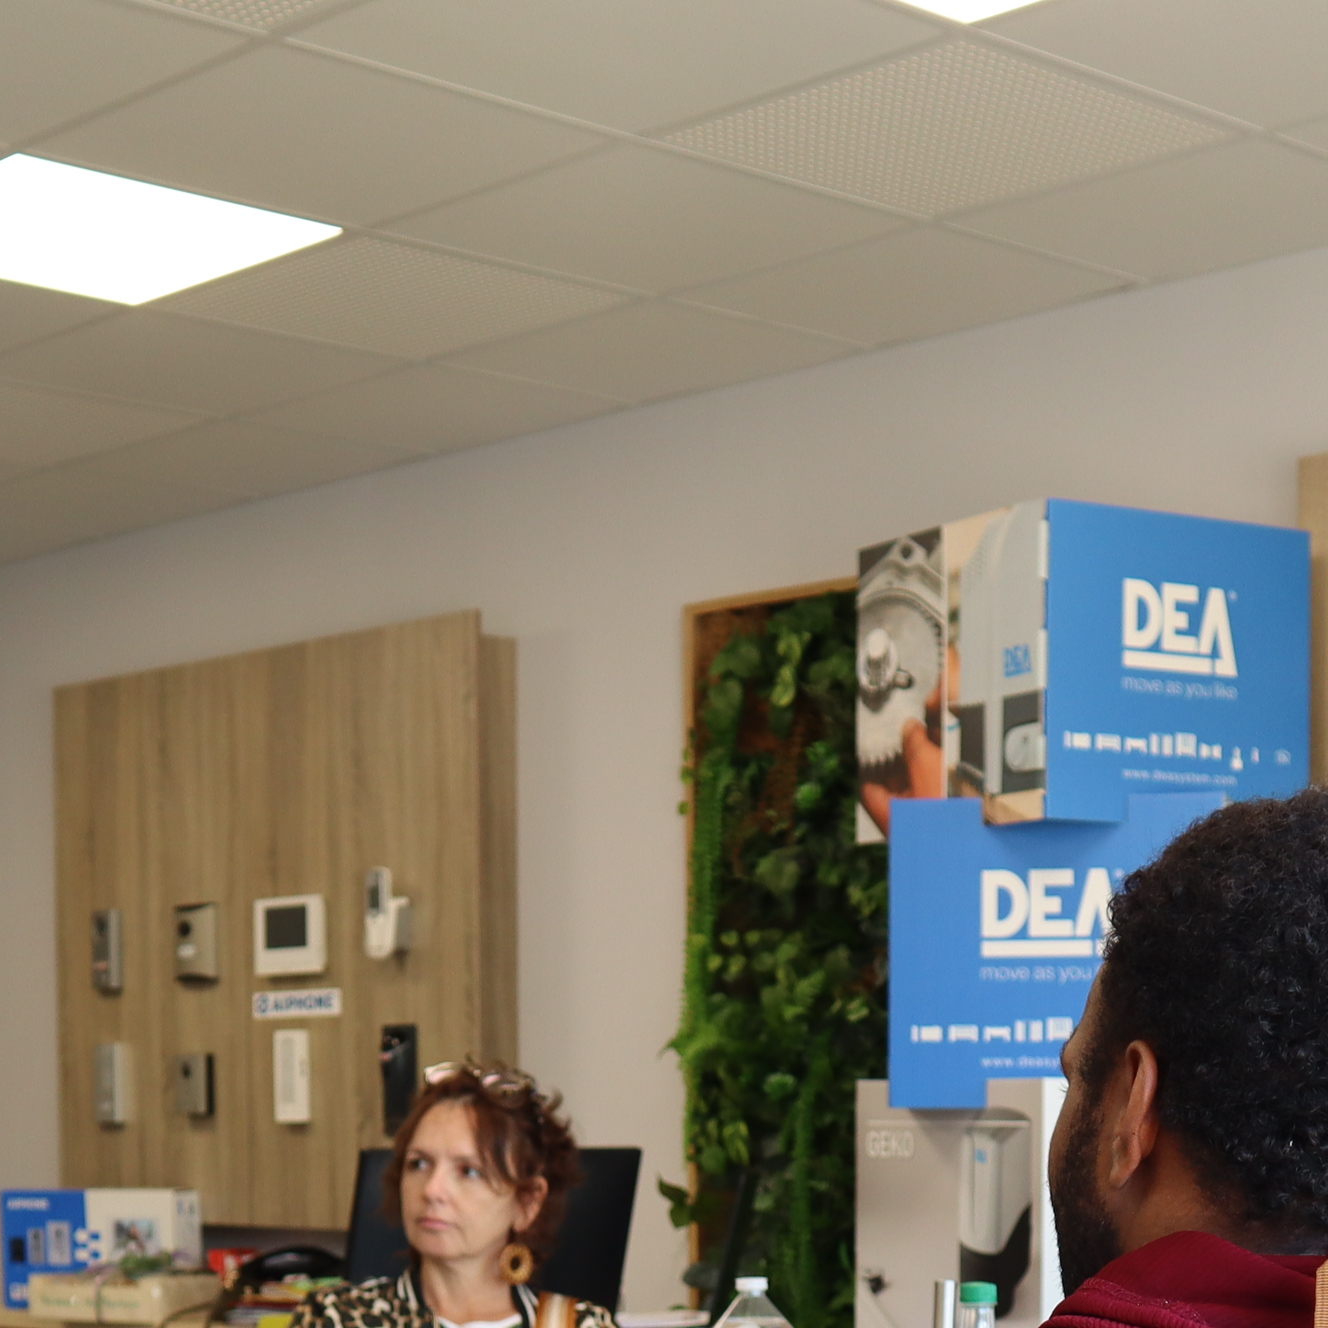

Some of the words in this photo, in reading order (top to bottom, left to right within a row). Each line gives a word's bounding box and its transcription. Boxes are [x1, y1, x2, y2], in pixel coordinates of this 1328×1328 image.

[1122, 577, 1239, 678] DEA
[1122, 677, 1164, 692] move
[1166, 680, 1184, 695] as
[1185, 683, 1212, 698] you
[981, 867, 1114, 958] DEA
[980, 966, 1030, 981] move
[1033, 966, 1056, 981] as
[1059, 966, 1093, 985] you
[866, 1131, 914, 1158] GEKO
